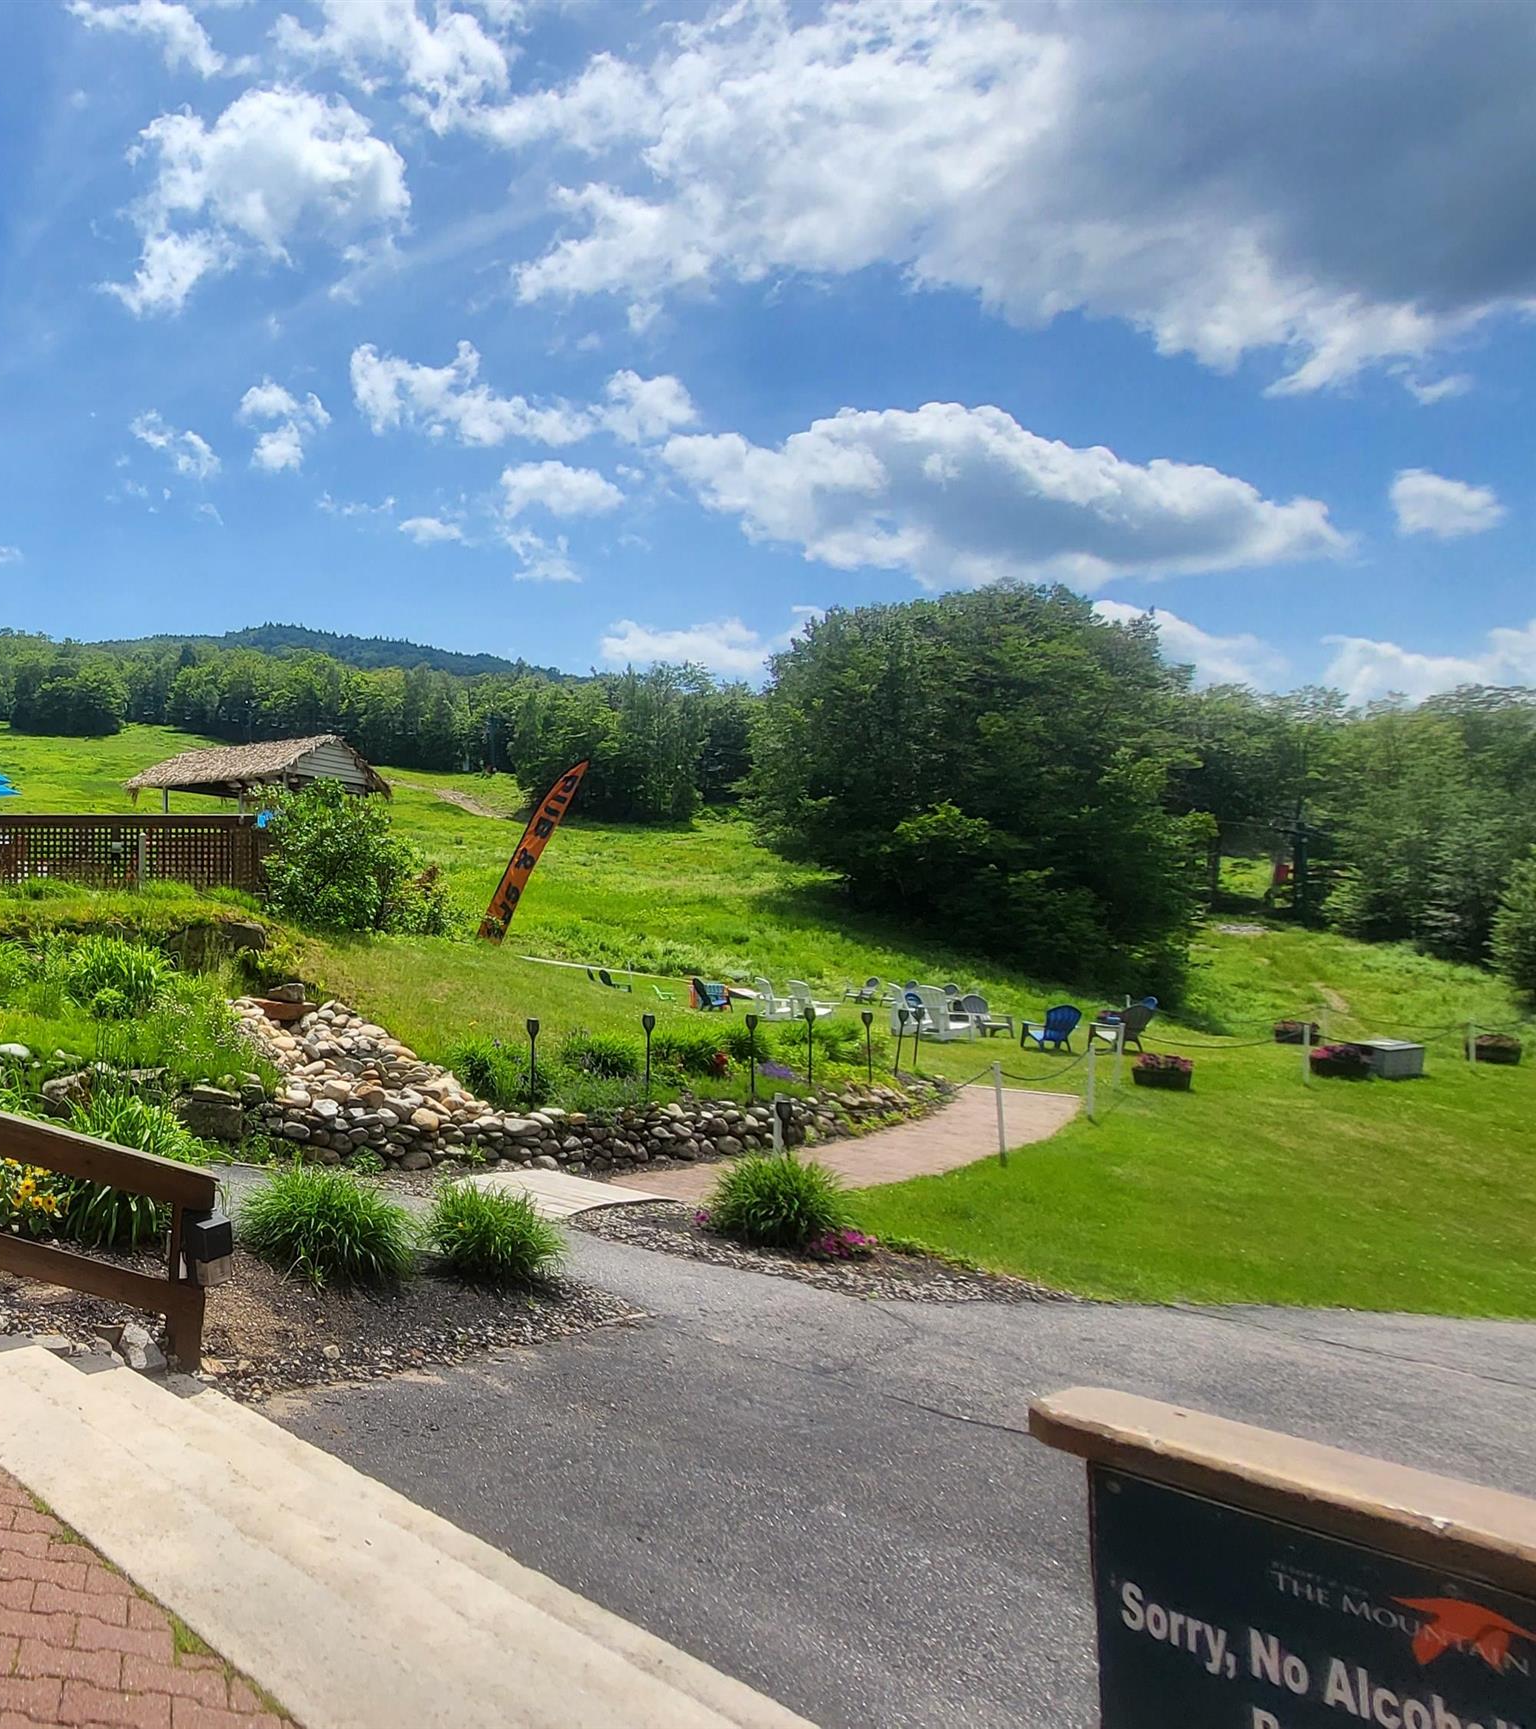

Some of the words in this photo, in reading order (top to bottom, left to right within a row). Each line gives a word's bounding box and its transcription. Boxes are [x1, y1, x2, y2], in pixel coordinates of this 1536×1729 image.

[1270, 1569, 1331, 1608] THE
[1121, 1581, 1237, 1680] Sorry,
[1248, 1626, 1310, 1695] No
[1324, 1656, 1525, 1729] Alcoh
